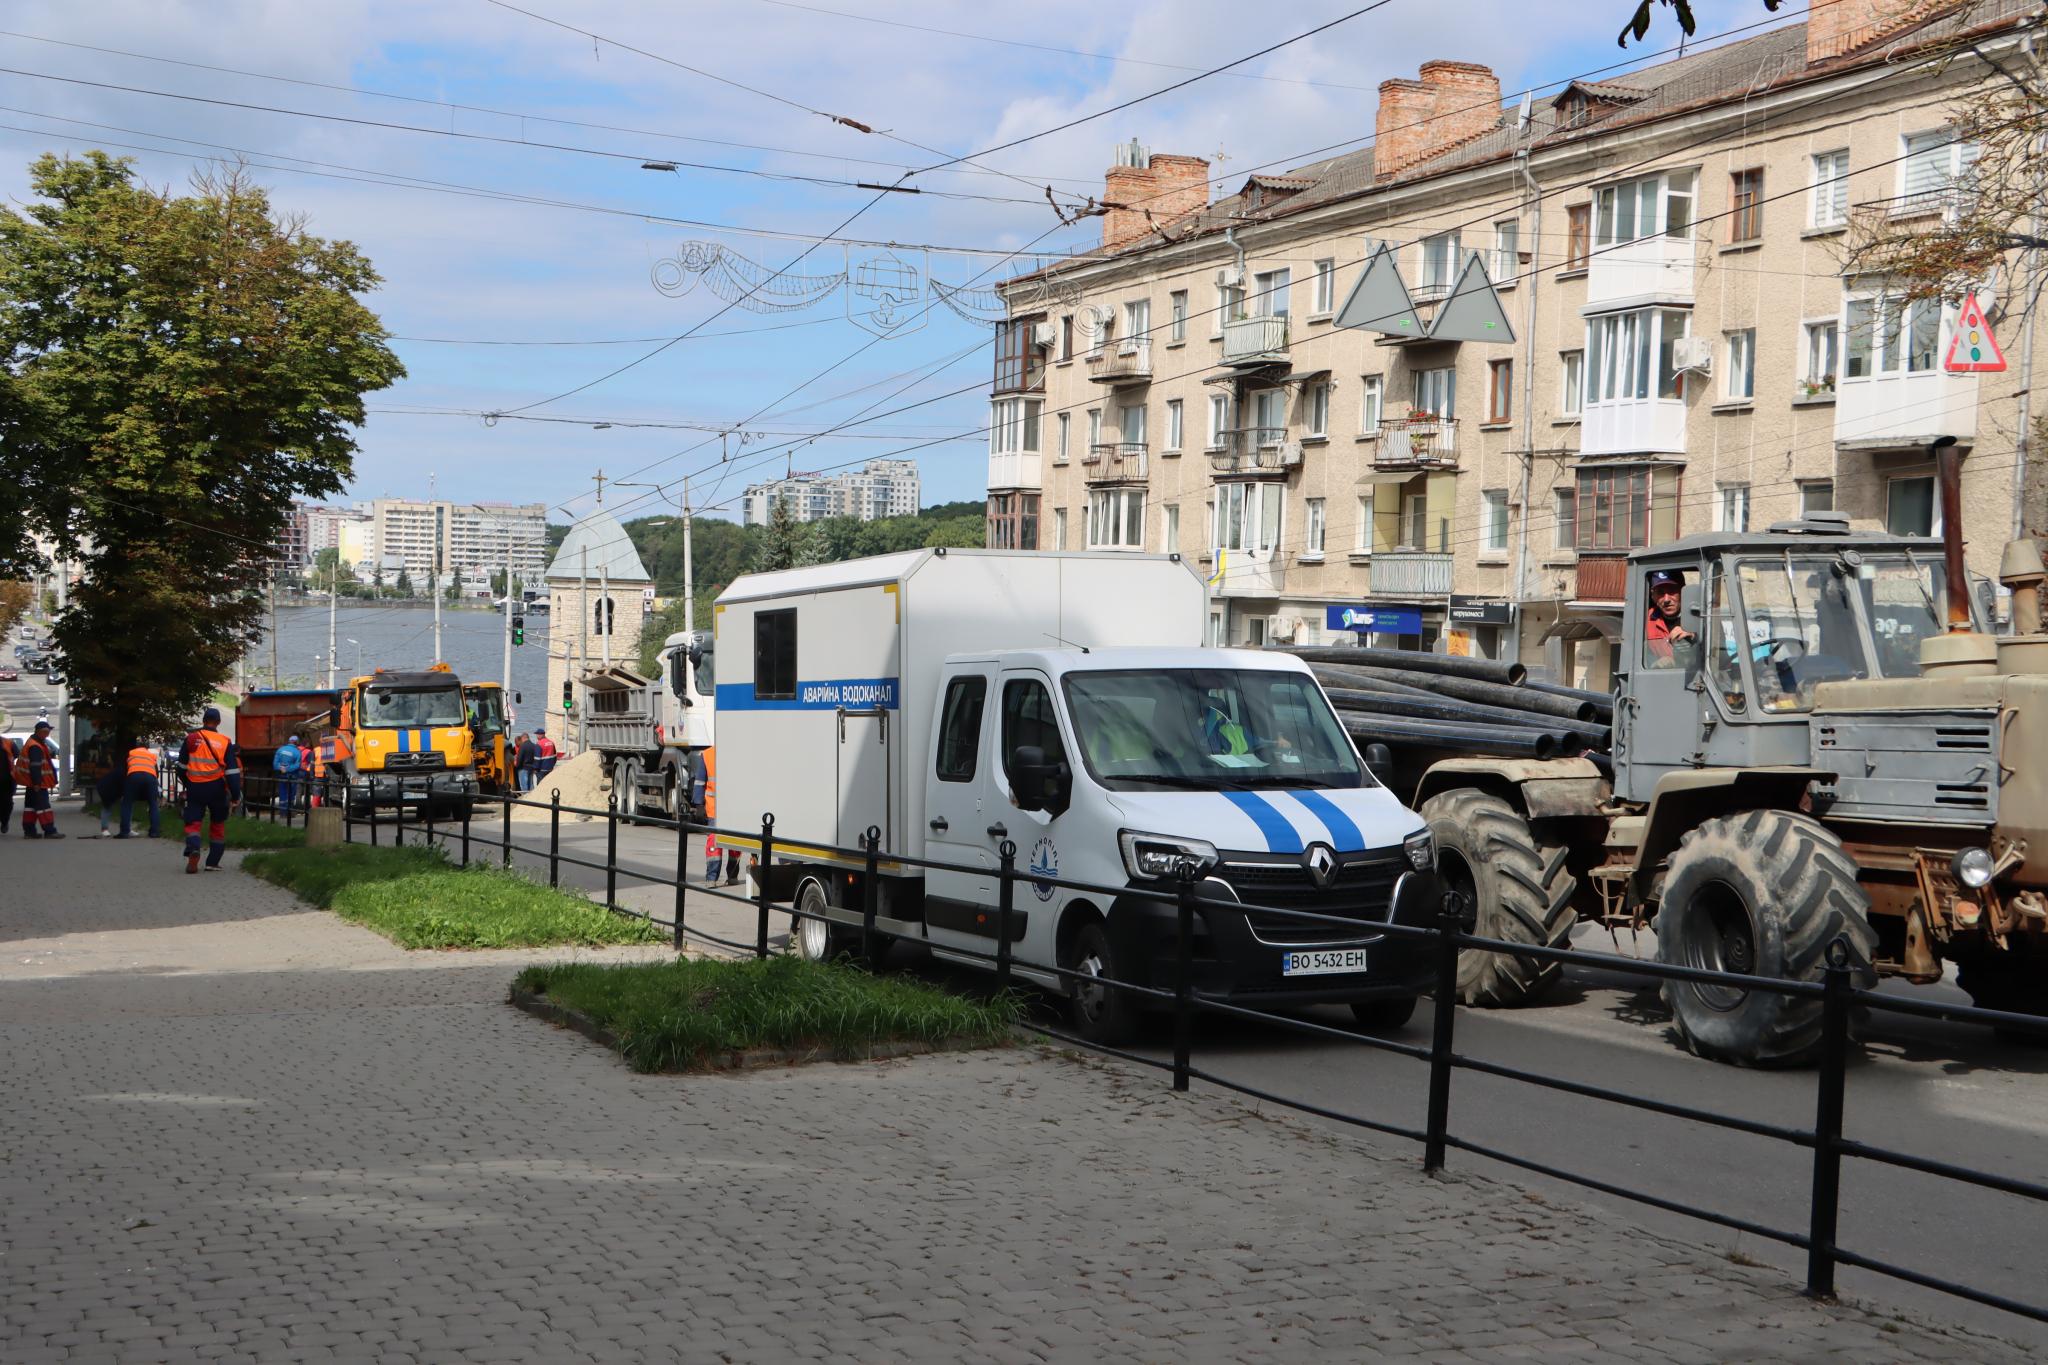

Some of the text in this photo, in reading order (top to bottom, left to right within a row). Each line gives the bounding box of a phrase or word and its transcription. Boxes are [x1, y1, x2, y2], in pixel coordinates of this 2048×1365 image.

[803, 683, 892, 705] АВАРІЙНА ВОДОКАНАЛ
[1291, 952, 1364, 969] BO 5432 EH
